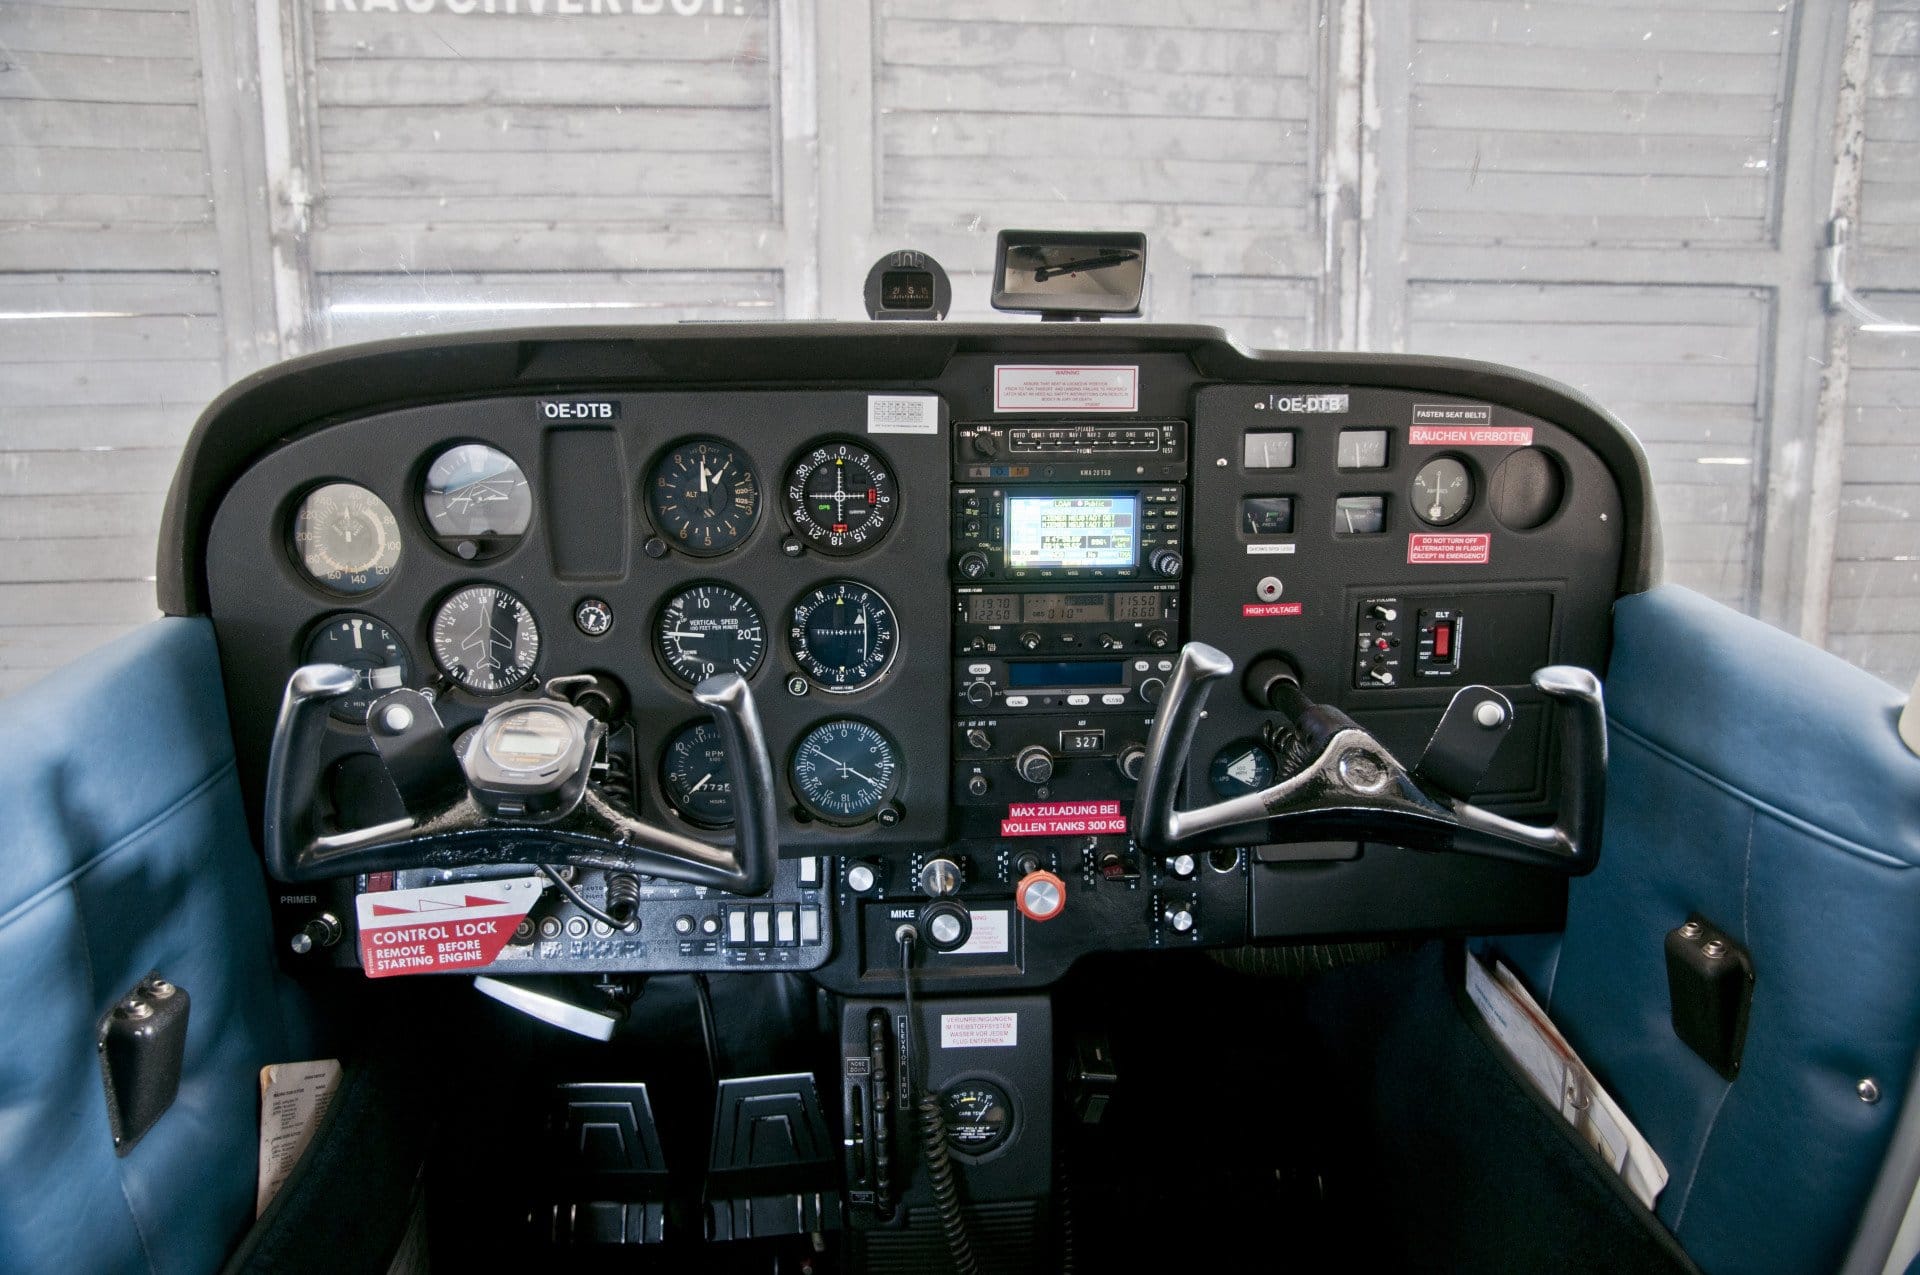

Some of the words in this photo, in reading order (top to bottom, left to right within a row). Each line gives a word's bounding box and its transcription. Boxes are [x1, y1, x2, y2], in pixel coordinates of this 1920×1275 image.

[1278, 398, 1340, 412] OE-DTB
[545, 403, 612, 418] OE-DTB
[1412, 431, 1466, 441] RAUCHEN
[1470, 431, 1528, 442] VERBOTEN
[699, 445, 706, 454] 0
[840, 446, 846, 455] 0
[812, 450, 826, 461] 33
[861, 454, 869, 463] 3
[796, 464, 808, 478] 30
[744, 472, 751, 482] 2
[876, 473, 886, 481] 6
[658, 478, 666, 487] 8
[790, 486, 799, 499] 27
[745, 506, 752, 516] 3
[793, 510, 805, 522] 24
[872, 516, 884, 527] 12
[680, 530, 688, 539] 6
[729, 528, 736, 536] 4
[808, 528, 821, 540] 21
[704, 537, 712, 546] 5
[832, 537, 842, 546] 18
[854, 532, 866, 542] 15
[387, 542, 401, 550] 100
[376, 566, 390, 575] 120
[328, 571, 341, 580] 160
[351, 575, 366, 584] 140
[460, 602, 469, 611] 15
[498, 600, 507, 609] 21
[698, 598, 710, 608] 10
[798, 606, 808, 616] 33
[448, 616, 456, 626] 12
[330, 630, 338, 640] L
[382, 630, 390, 640] R
[522, 632, 530, 641] 27
[738, 630, 751, 640] 20
[792, 628, 800, 638] 30
[882, 631, 890, 640] 12
[518, 651, 528, 660] 30
[796, 651, 806, 660] W
[875, 653, 884, 662] 15
[505, 666, 516, 675] 33
[702, 663, 714, 674] 10
[813, 667, 823, 676] 24
[859, 668, 866, 677] S
[696, 726, 704, 734] 15
[841, 730, 848, 738] 0
[822, 733, 834, 744] 33
[1076, 737, 1098, 748] 327
[676, 742, 684, 751] 10
[806, 761, 816, 772] 27
[670, 772, 678, 781] 5
[812, 776, 822, 788] 24
[824, 790, 834, 798] 21
[858, 788, 868, 798] 15
[684, 795, 690, 804] 0
[1012, 807, 1035, 816] MAX
[1038, 806, 1097, 816] ZULADUNG
[1100, 804, 1118, 814] BEI
[1003, 822, 1046, 832] VOLLEN
[1049, 822, 1085, 831] TANKS
[1088, 820, 1106, 830] 300
[1108, 820, 1124, 830] KG
[1130, 840, 1134, 852] UP
[280, 896, 317, 904] PRIMER
[890, 910, 914, 918] MIKE
[374, 926, 449, 944] CONTROL
[456, 922, 496, 936] LOCK
[376, 945, 425, 959] REMOVE
[438, 940, 480, 953] BEFORE
[378, 956, 434, 970] STARTING
[439, 950, 482, 964] ENGINE
